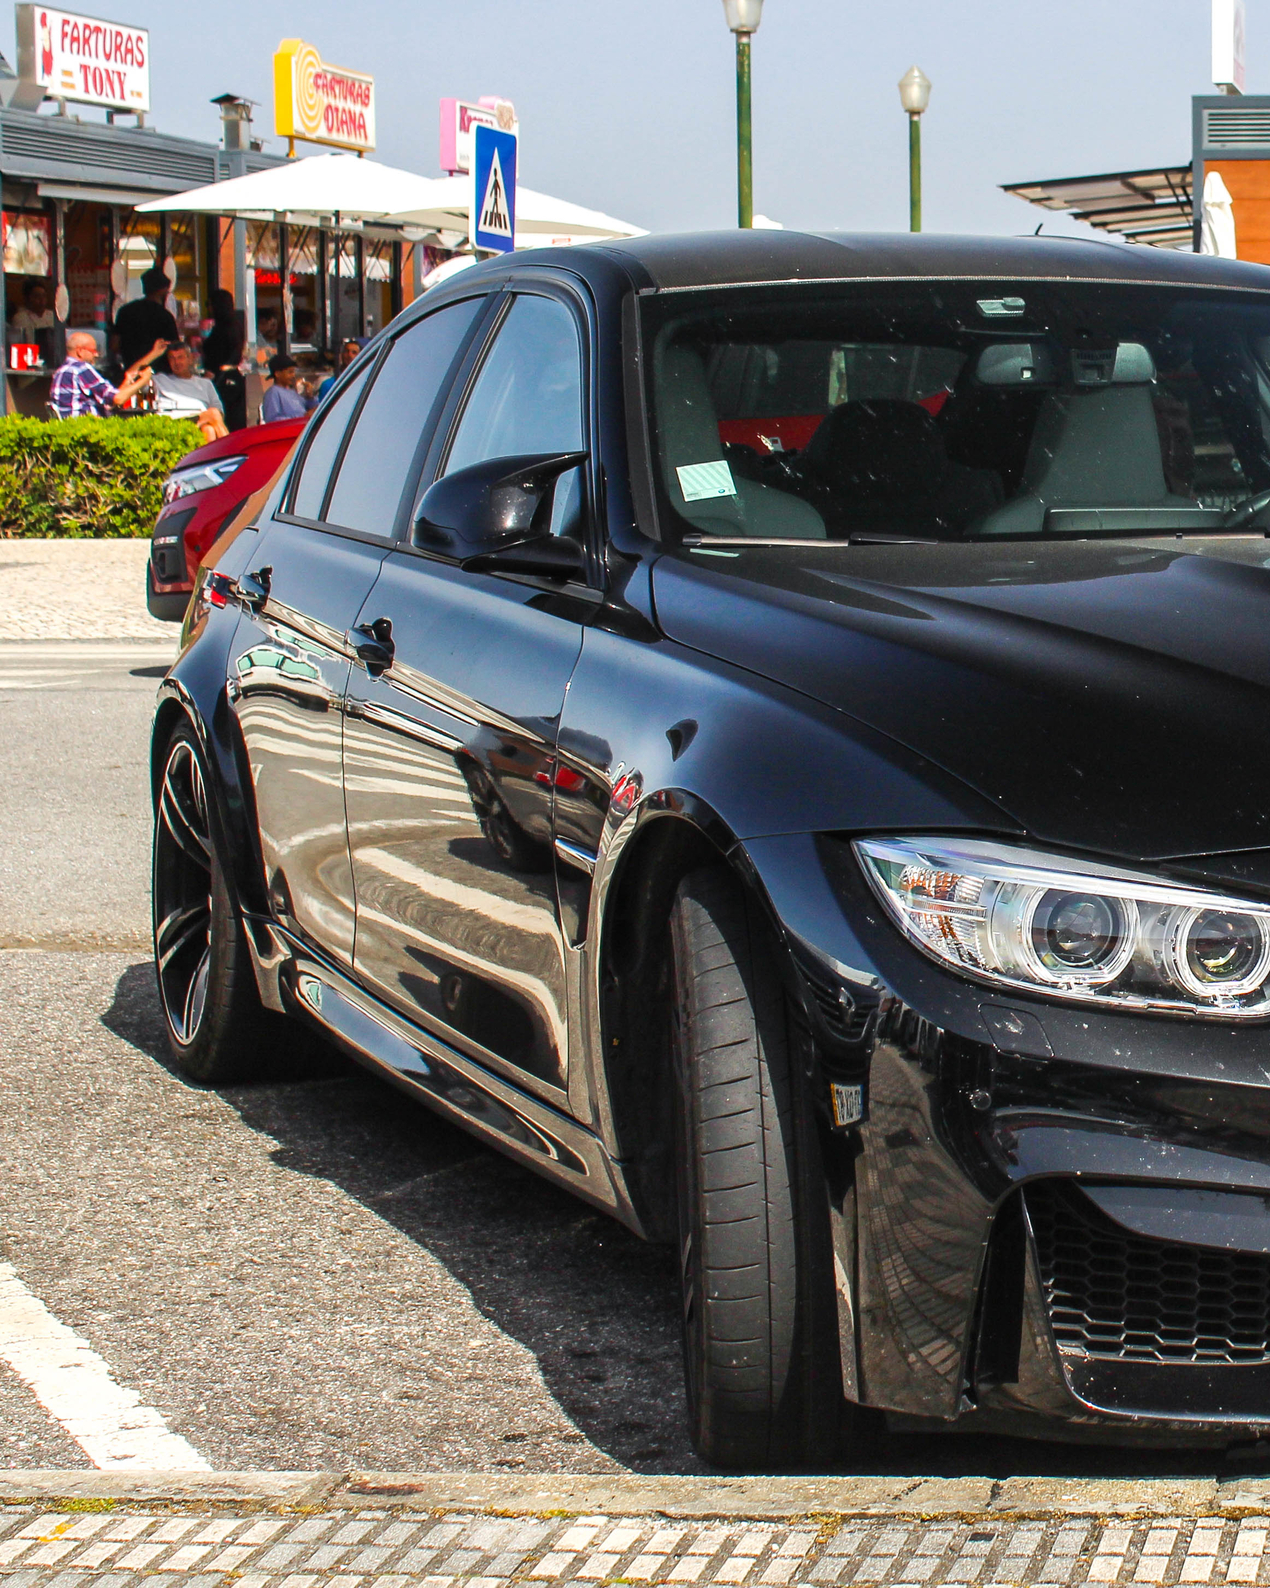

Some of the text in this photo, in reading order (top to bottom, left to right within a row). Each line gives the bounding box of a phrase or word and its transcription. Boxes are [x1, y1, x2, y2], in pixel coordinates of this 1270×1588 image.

[61, 18, 145, 68] FARTURAS
[79, 63, 127, 101] TONY
[313, 72, 371, 107] FARTURAS
[323, 103, 368, 142] DIANA
